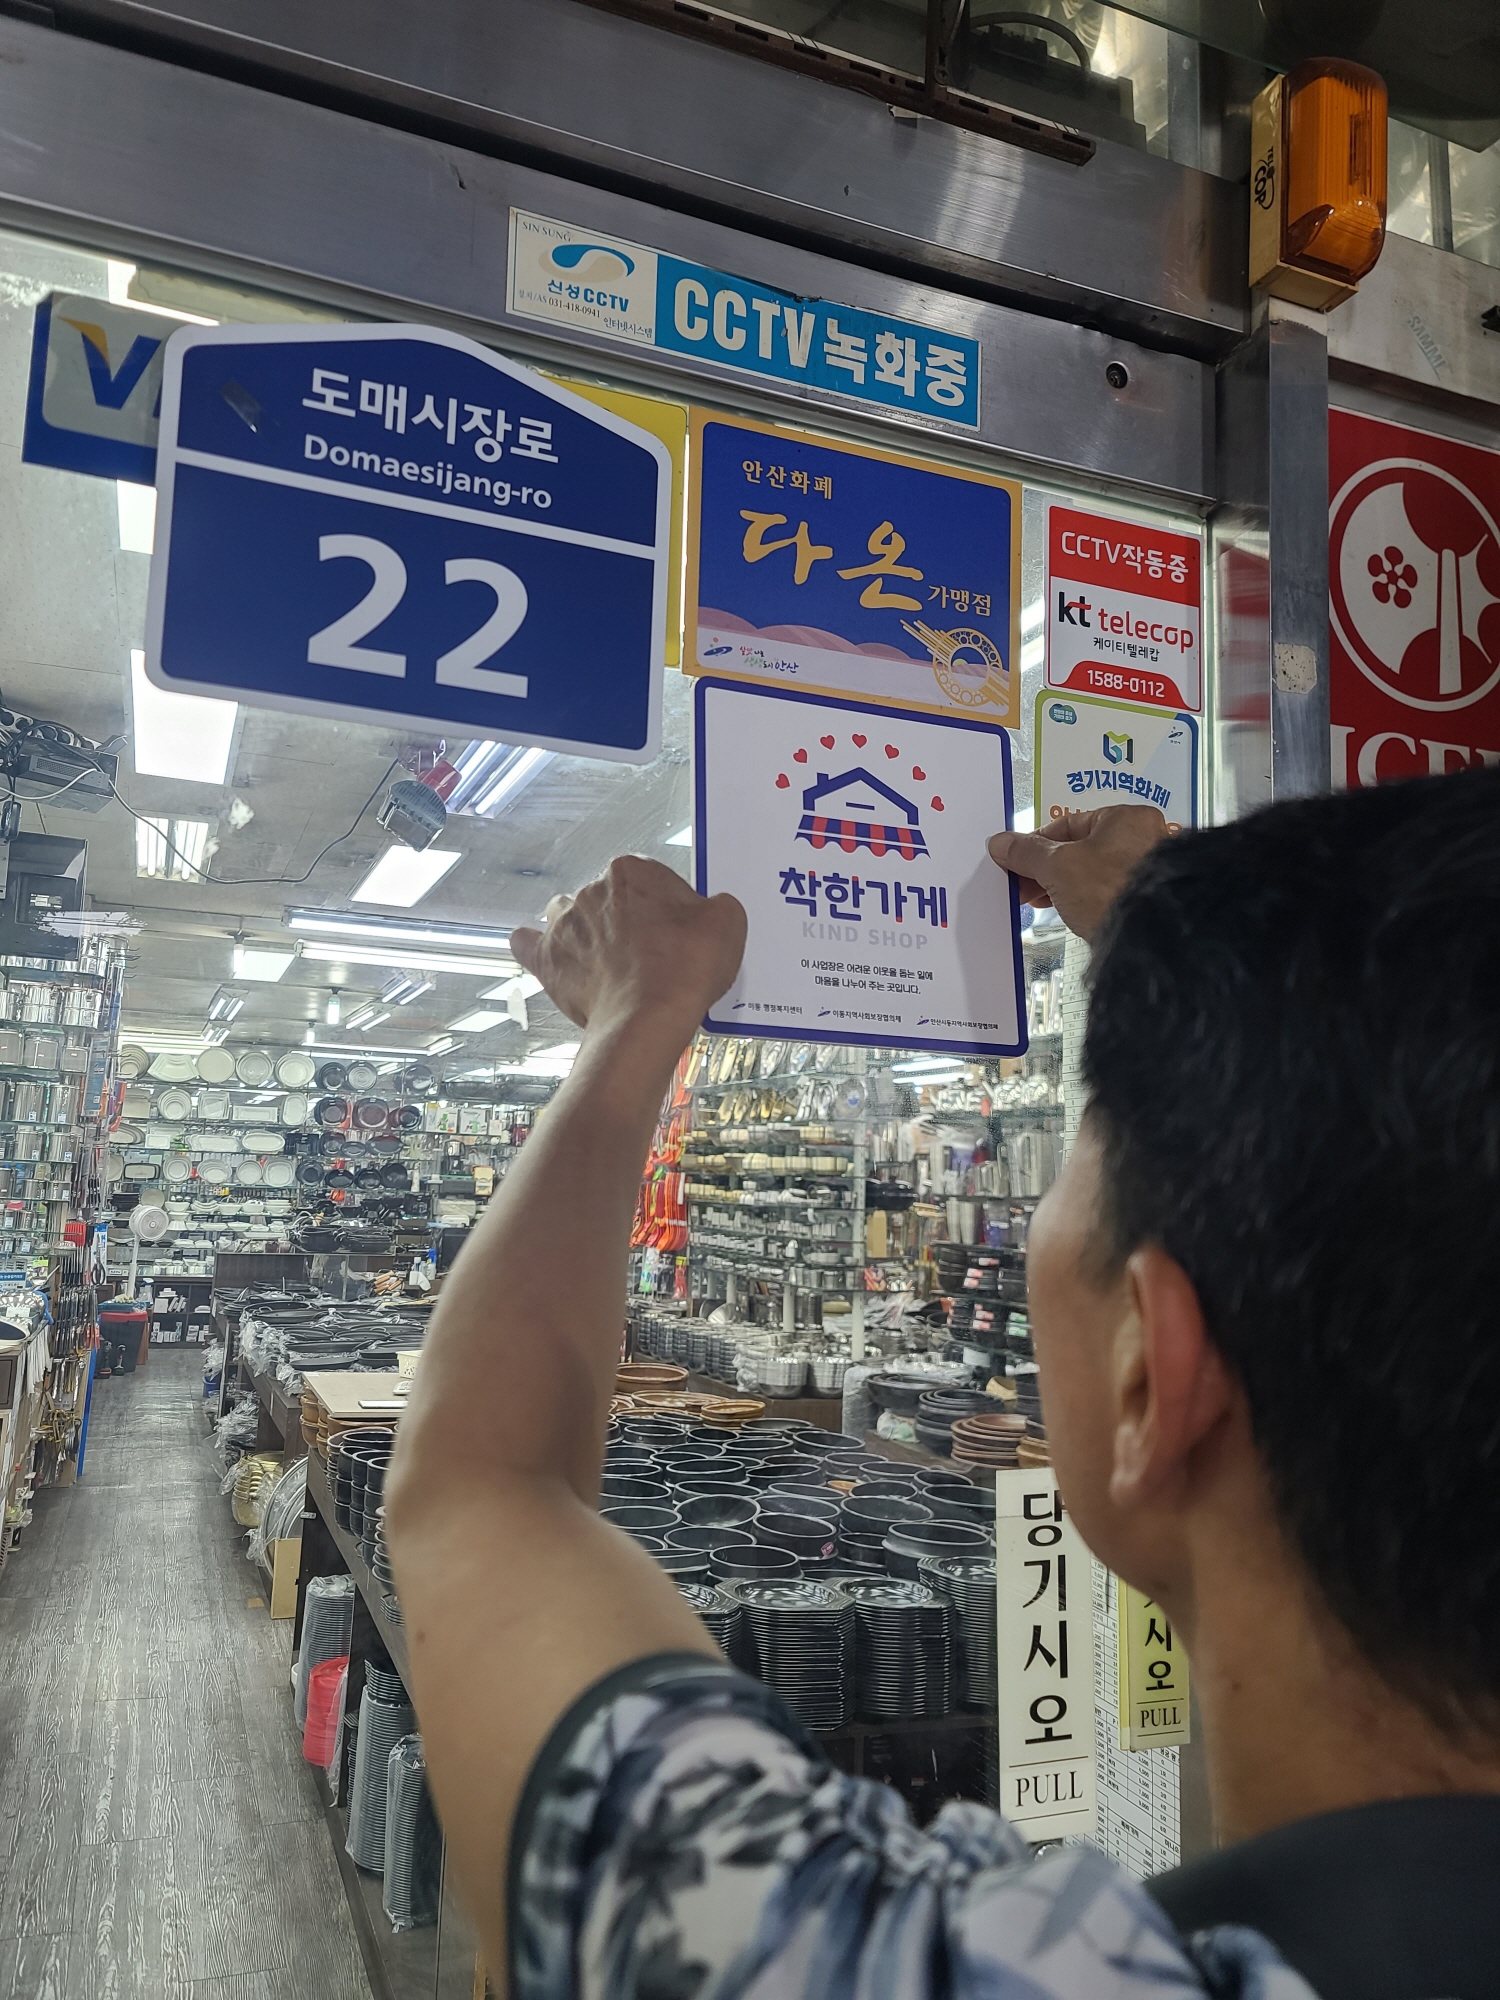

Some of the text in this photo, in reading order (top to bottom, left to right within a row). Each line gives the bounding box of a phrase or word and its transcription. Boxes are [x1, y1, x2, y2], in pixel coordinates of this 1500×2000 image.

[522, 221, 572, 242] SIN SUNG
[548, 297, 600, 318] 031-418-0941
[604, 317, 653, 338] 인터넷시스템
[301, 368, 560, 465] 도매시장로
[303, 432, 553, 511] Domaesijang-ro
[741, 460, 833, 500] 안산화폐
[1061, 531, 1189, 584] CCTV작동중
[307, 533, 529, 699] 22
[927, 585, 992, 617] 가맹점
[1058, 591, 1195, 654] kt telecop
[1093, 636, 1161, 663] 케이티텔레캅
[1087, 669, 1166, 699] 1588-0112
[1066, 769, 1171, 809] 경기지역화폐
[779, 867, 949, 929] 착한가게
[802, 921, 928, 950] KIND SHOP
[800, 959, 810, 969] 이
[811, 960, 845, 973] 사업장은
[846, 964, 871, 975] 어려운
[873, 966, 898, 978] 이웃을
[917, 970, 934, 981] 일에
[814, 976, 921, 995] 마음을 나누어 주는 곳입니다.
[1022, 1490, 1073, 1746] 당기시오
[1144, 1600, 1175, 1691] 시오
[1140, 1706, 1182, 1728] PULL
[1015, 1770, 1084, 1808] PULL
